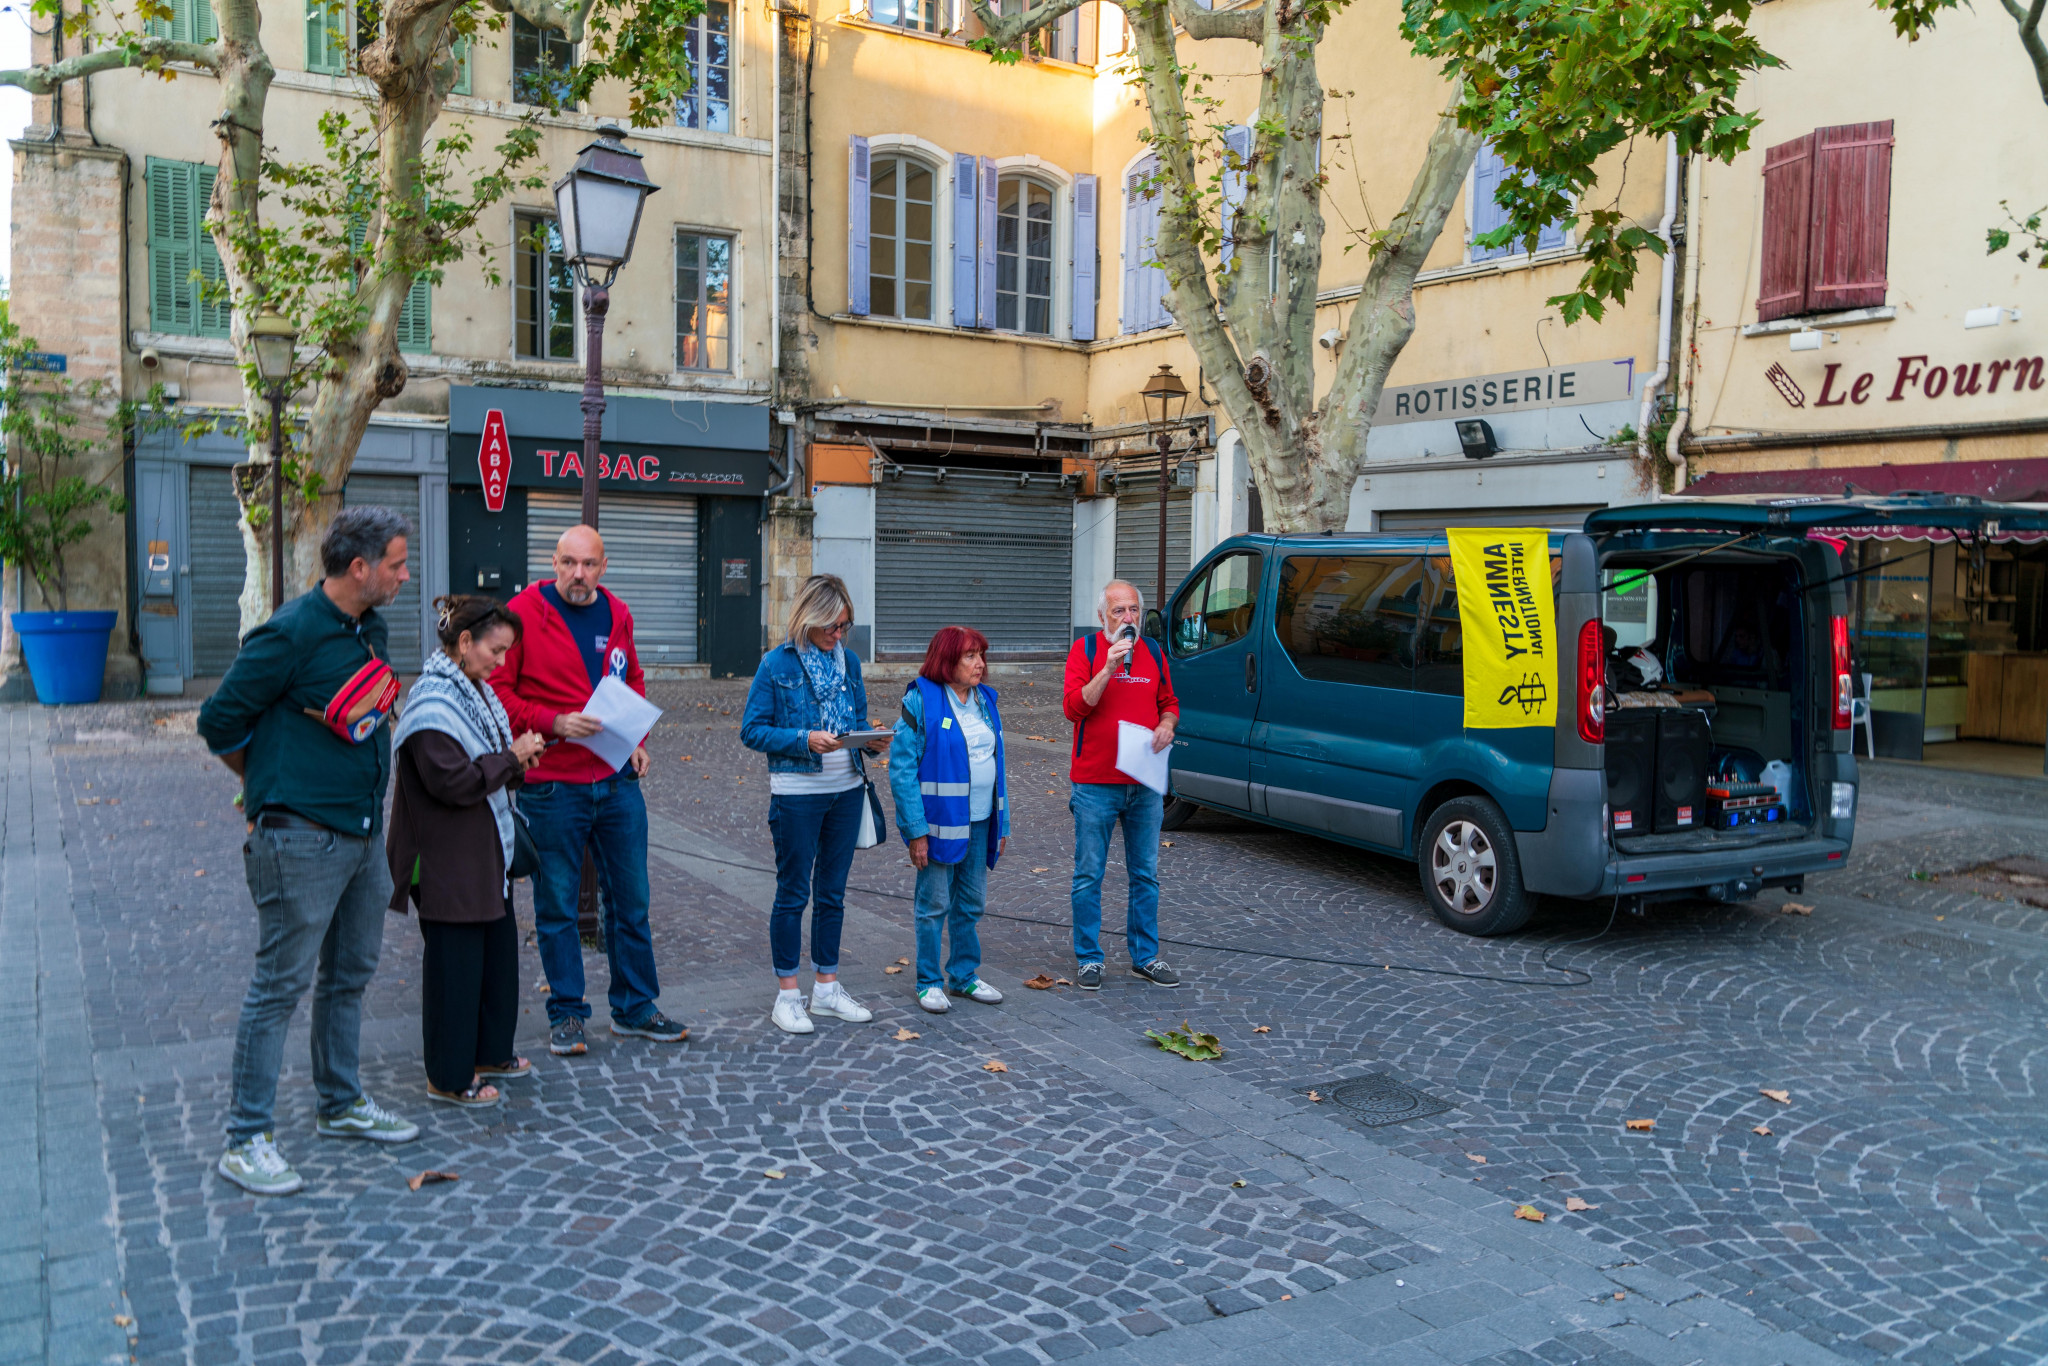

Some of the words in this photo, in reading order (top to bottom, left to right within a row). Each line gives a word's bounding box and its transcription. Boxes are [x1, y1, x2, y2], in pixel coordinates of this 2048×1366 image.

[1396, 372, 1576, 416] ROTISSERIE
[1813, 363, 1874, 407] Le
[1886, 355, 2046, 401] Fourn
[489, 423, 501, 497] TABAC
[536, 450, 660, 481] TABAC
